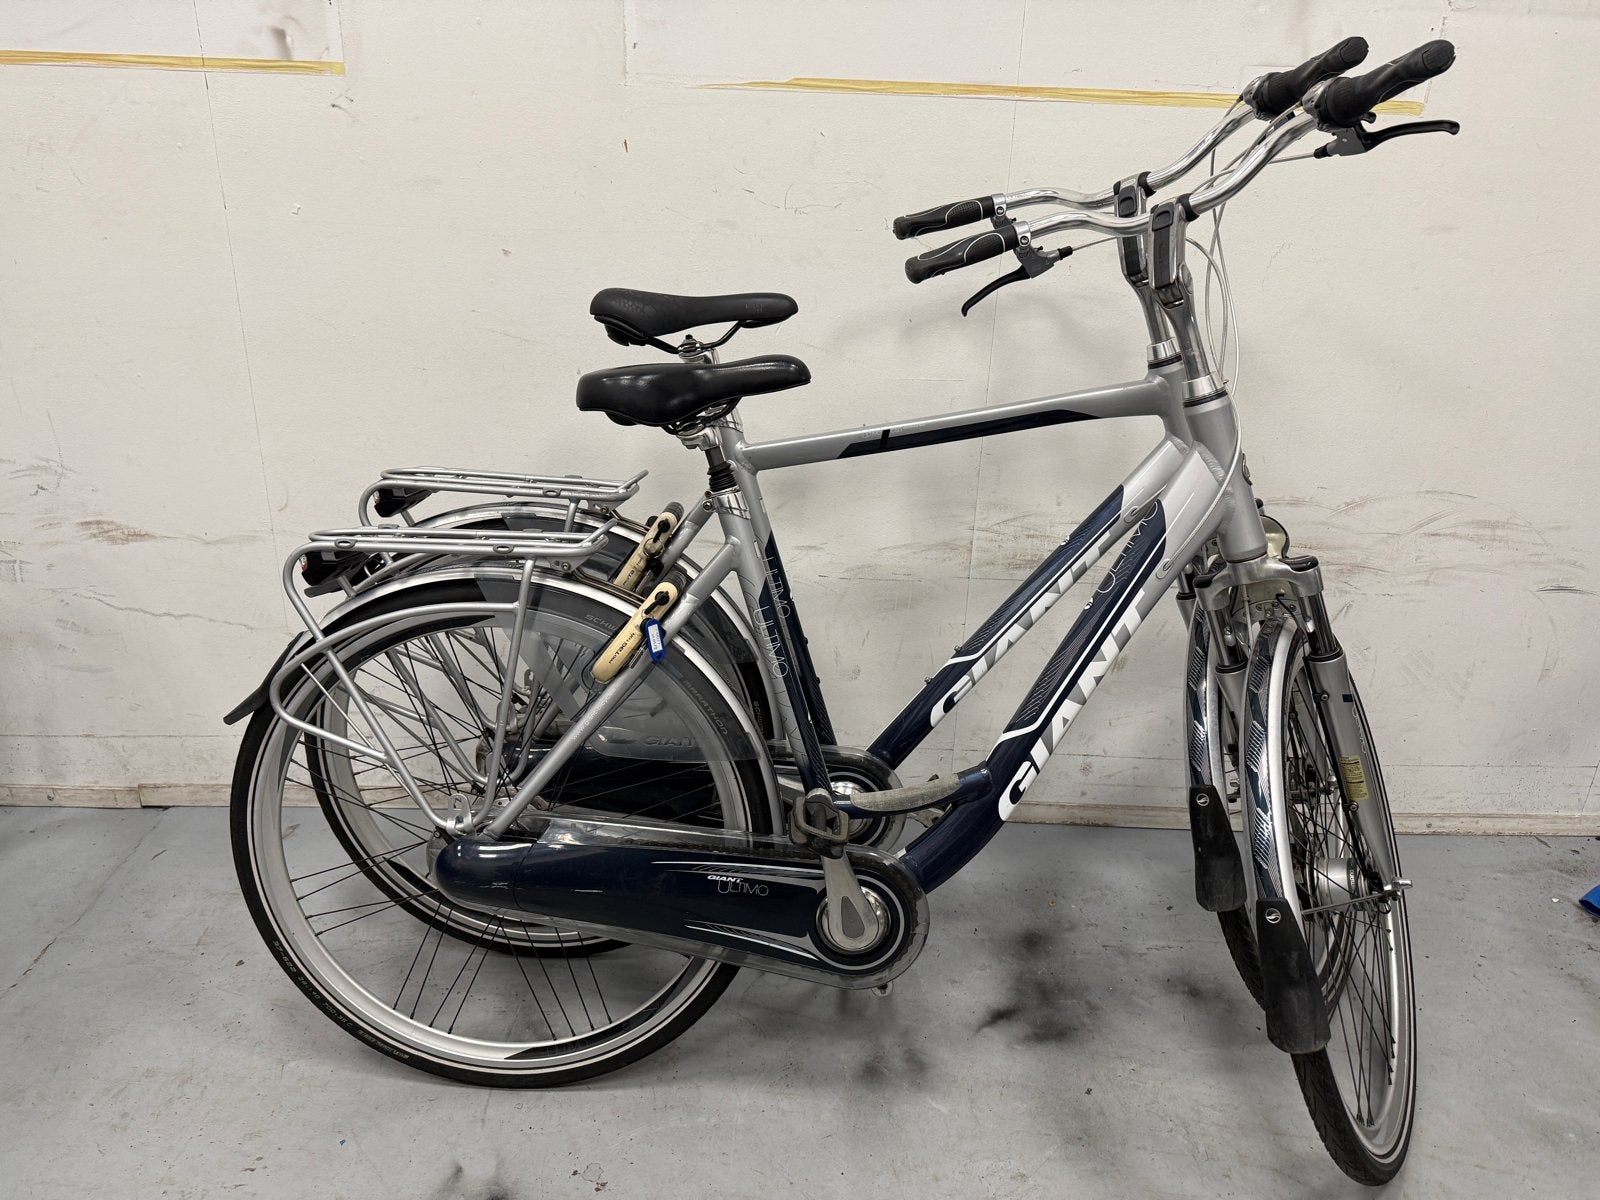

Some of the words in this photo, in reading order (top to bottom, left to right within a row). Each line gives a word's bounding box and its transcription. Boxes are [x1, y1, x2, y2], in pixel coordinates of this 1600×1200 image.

[584, 614, 619, 631] SCHW
[753, 605, 789, 678] ULTIMO
[930, 530, 1106, 728] GIANT
[998, 588, 1146, 822] GIANT
[707, 874, 744, 883] GIANT
[718, 878, 769, 897] ULTIMO
